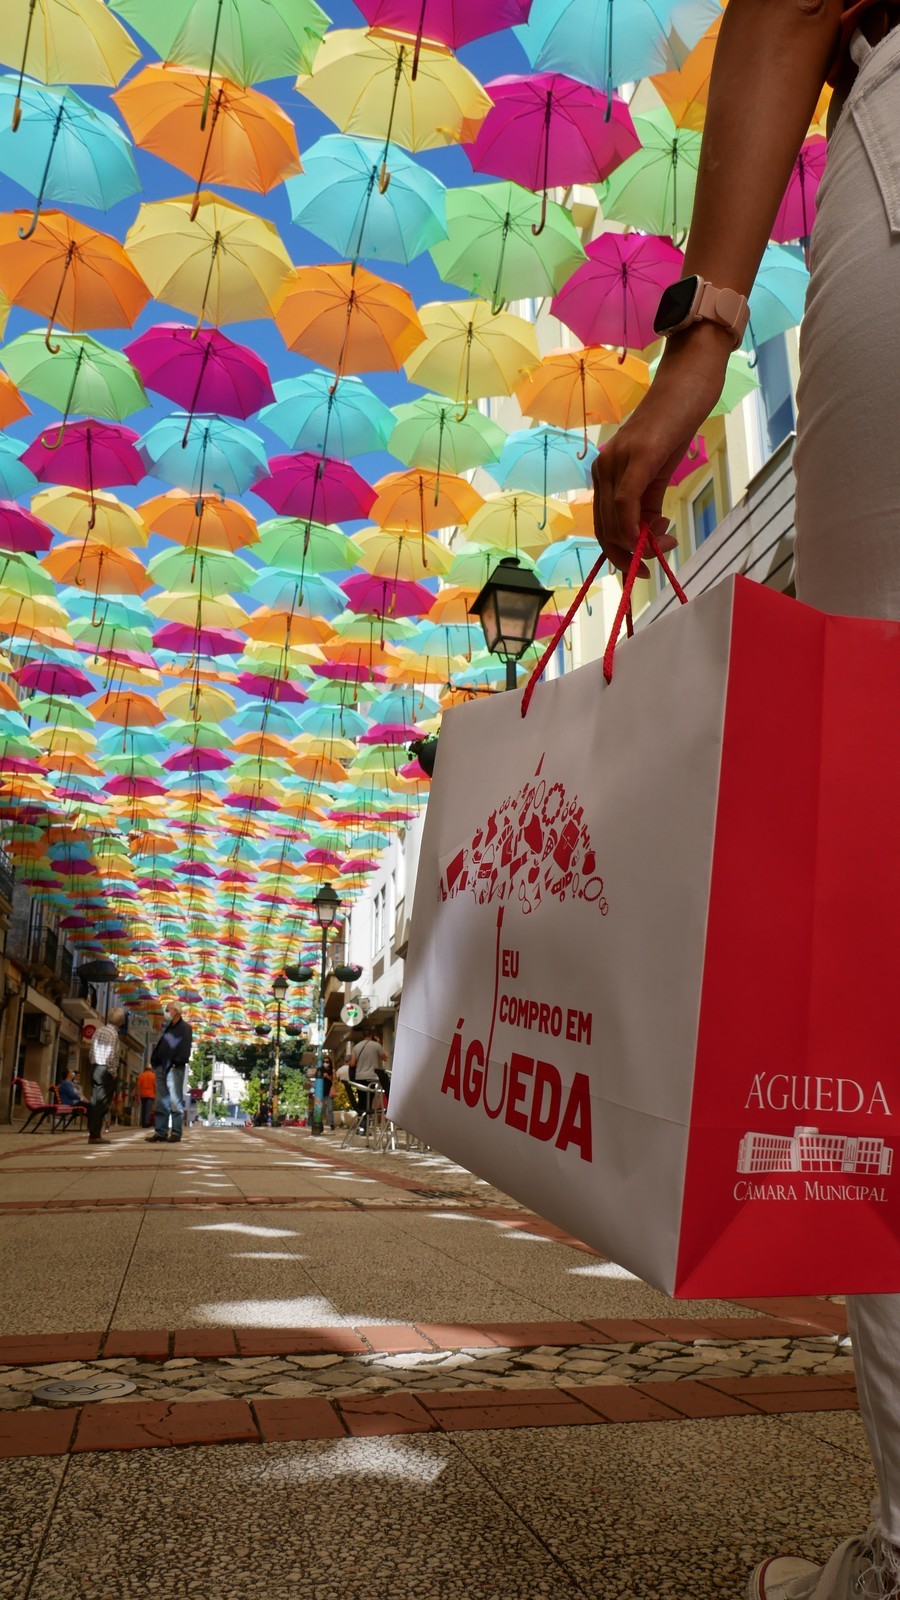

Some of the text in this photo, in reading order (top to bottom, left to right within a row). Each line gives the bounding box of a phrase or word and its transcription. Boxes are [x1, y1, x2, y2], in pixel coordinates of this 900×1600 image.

[501, 949, 520, 979] EU
[500, 994, 593, 1046] COMPRO EM
[440, 1017, 593, 1163] ÁGUEDA
[743, 1071, 892, 1116] ÁGUEDA
